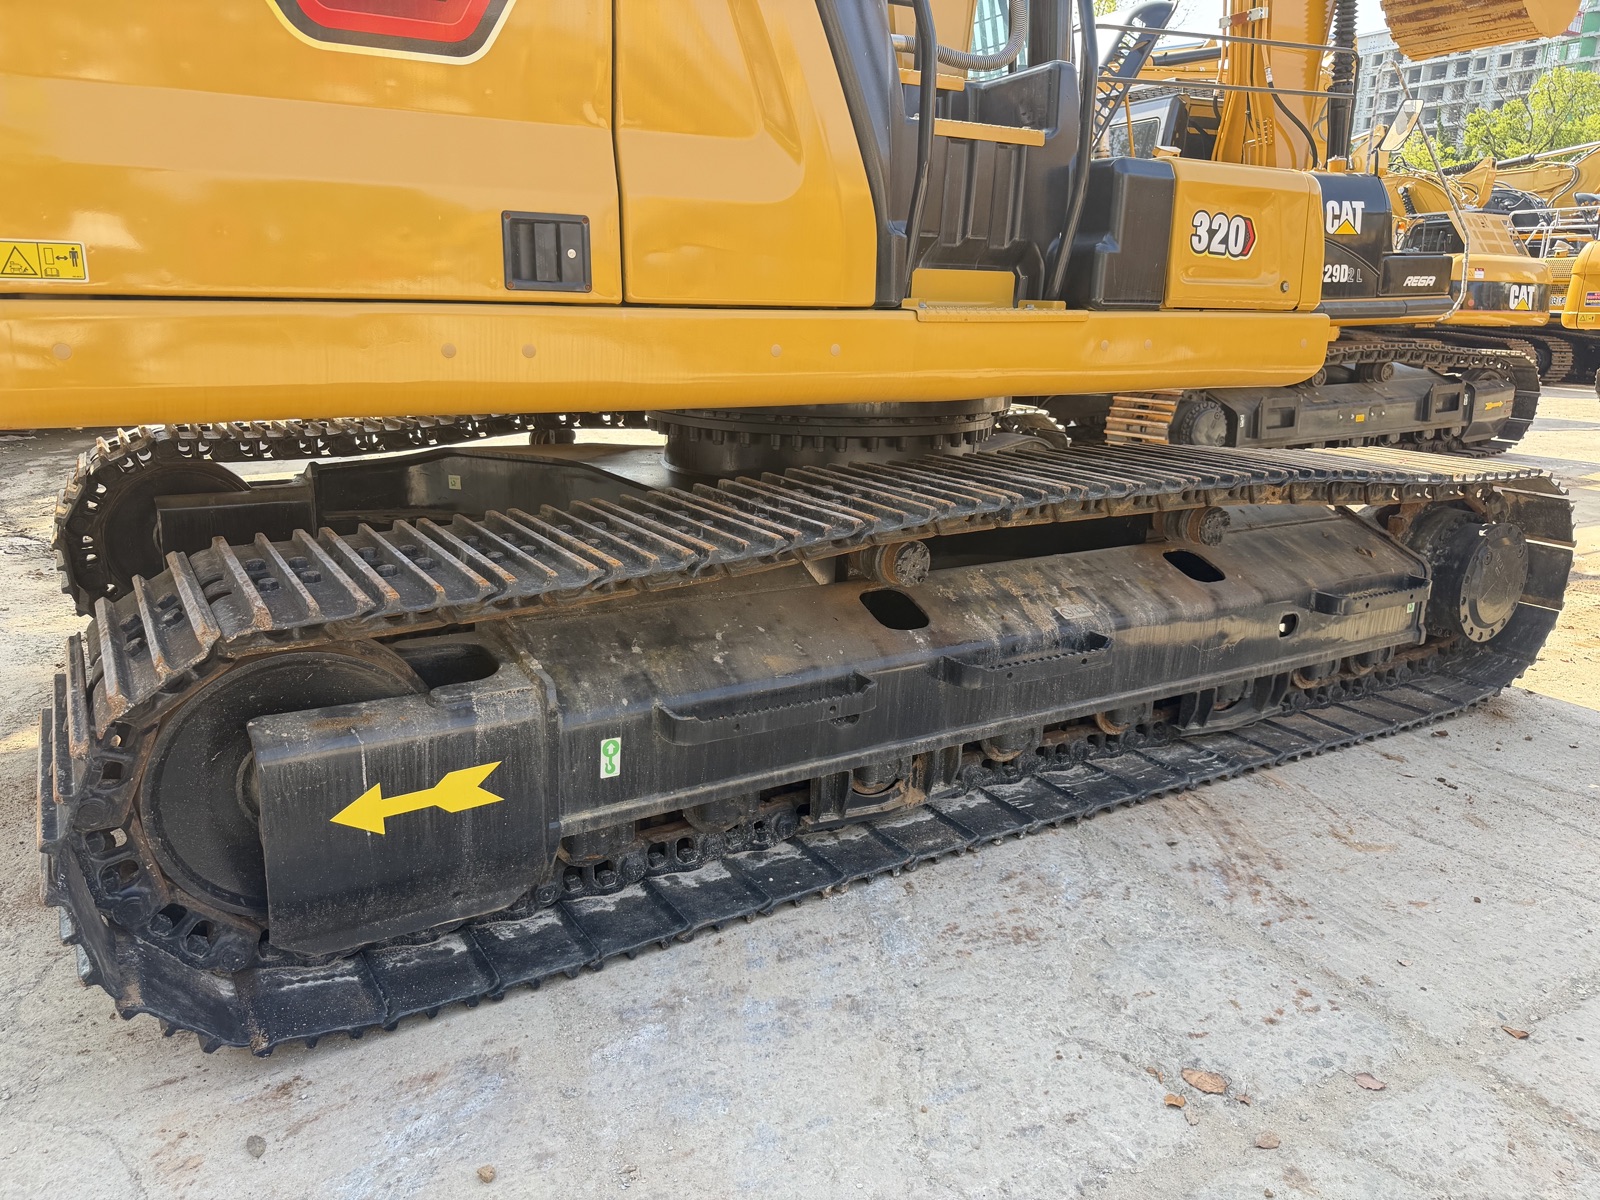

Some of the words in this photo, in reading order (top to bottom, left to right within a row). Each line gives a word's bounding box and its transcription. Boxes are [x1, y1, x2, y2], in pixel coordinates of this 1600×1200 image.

[1190, 210, 1246, 257] 320
[1326, 200, 1365, 235] CAT
[1509, 284, 1536, 311] CAT
